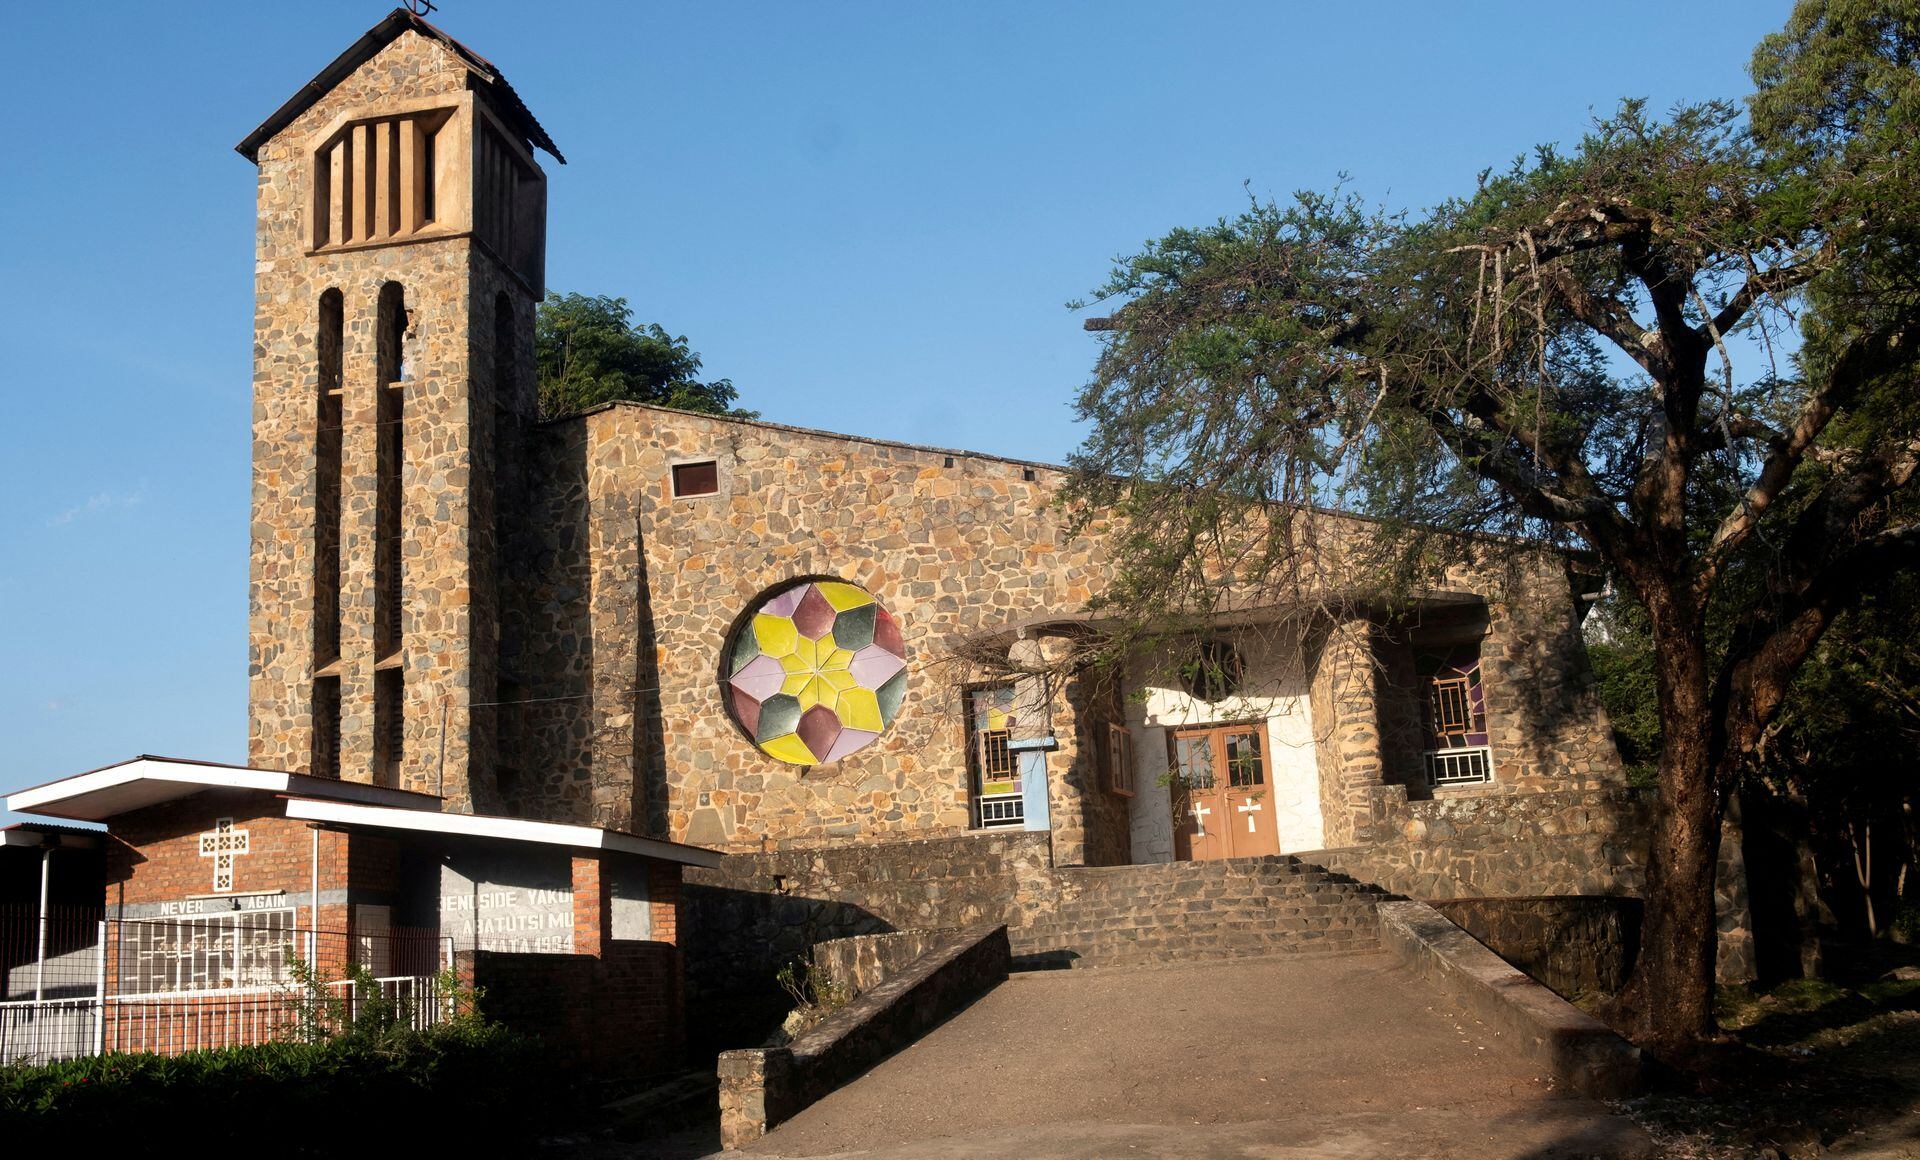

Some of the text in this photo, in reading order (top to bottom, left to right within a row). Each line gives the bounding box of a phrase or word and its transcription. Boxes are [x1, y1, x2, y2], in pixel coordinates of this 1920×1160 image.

[160, 895, 286, 916] NEVER AGAIN
[527, 886, 574, 906] YAKO
